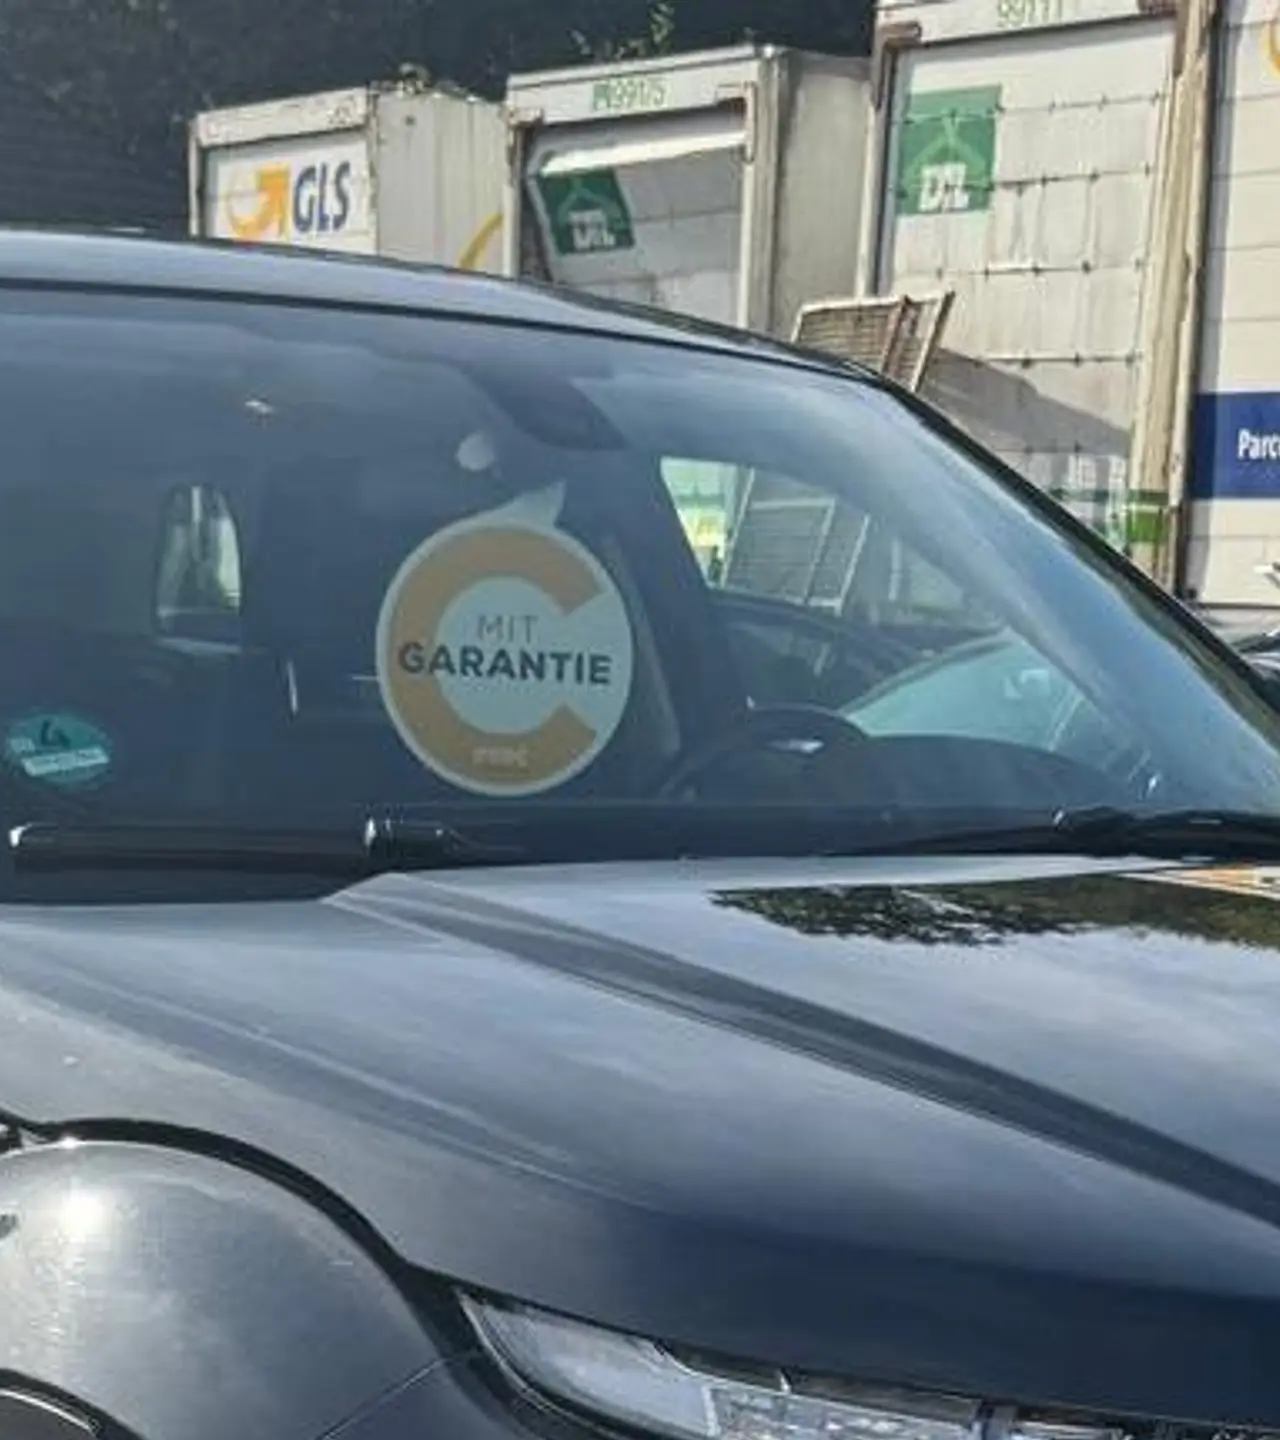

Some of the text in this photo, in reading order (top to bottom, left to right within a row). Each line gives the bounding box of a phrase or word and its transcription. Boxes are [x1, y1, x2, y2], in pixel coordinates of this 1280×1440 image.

[292, 161, 350, 233] GLS
[477, 614, 539, 643] MIT
[398, 641, 612, 686] GARANTIE
